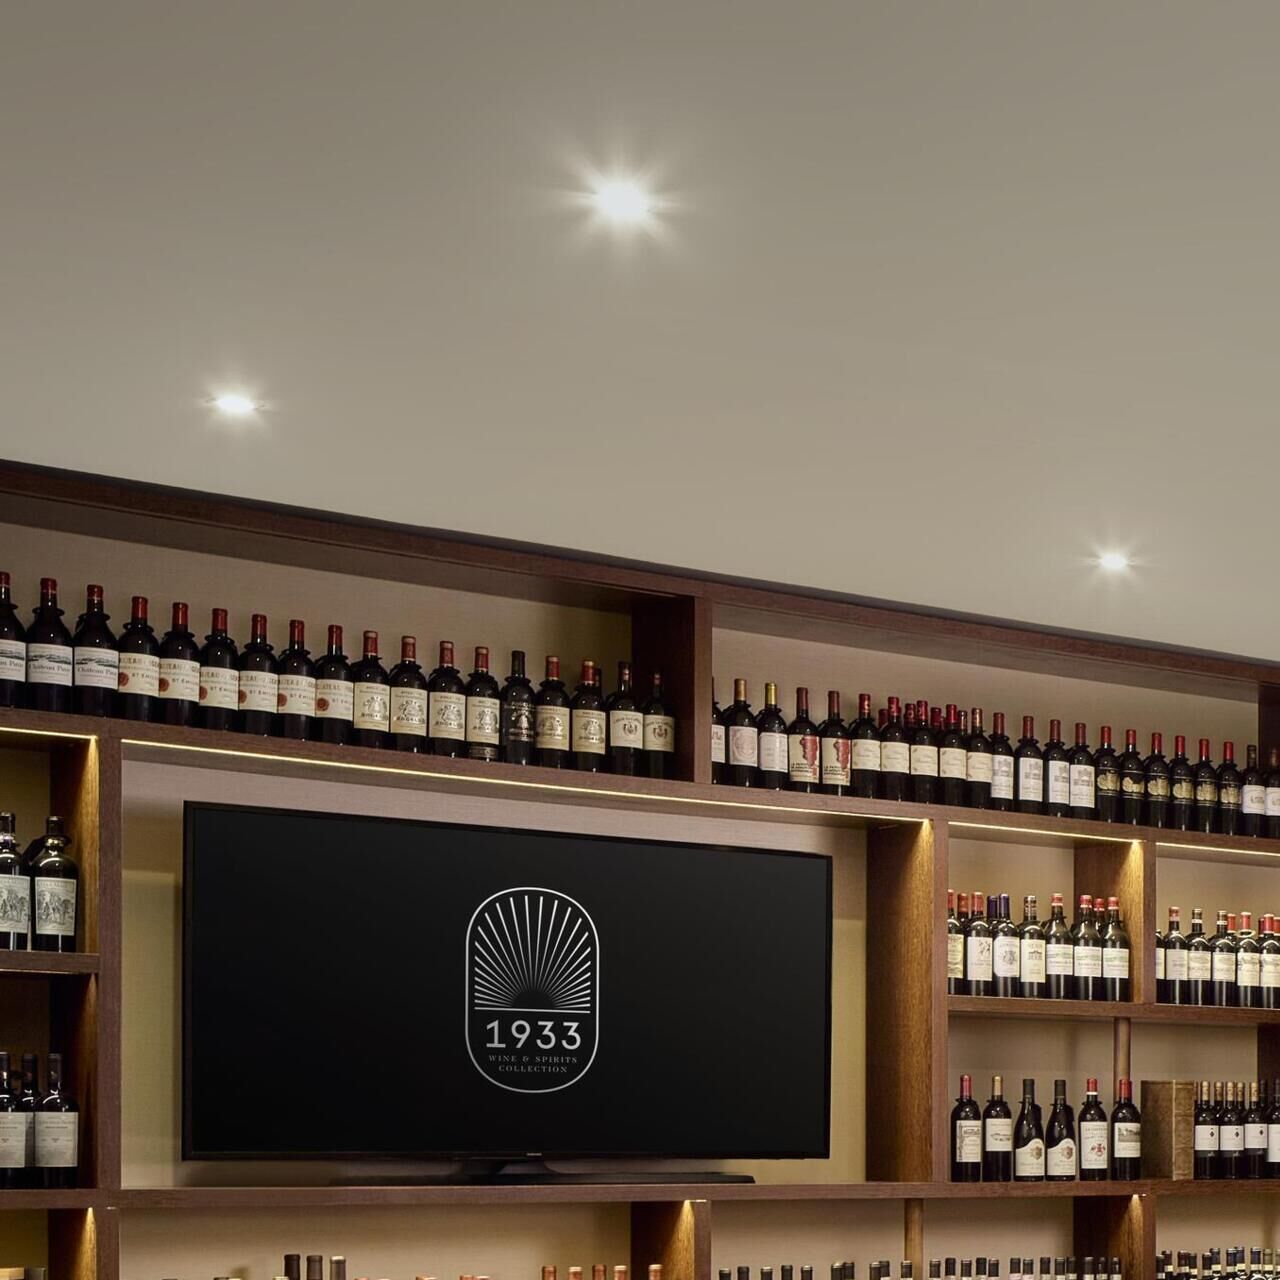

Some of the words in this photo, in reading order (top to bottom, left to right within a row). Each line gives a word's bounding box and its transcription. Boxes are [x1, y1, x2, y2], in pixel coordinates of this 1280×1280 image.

[486, 1019, 582, 1050] 1933
[488, 1054, 517, 1063] WINE
[522, 1055, 531, 1064] &
[535, 1056, 578, 1064] SPIRITS
[498, 1065, 568, 1073] COLLECTION
